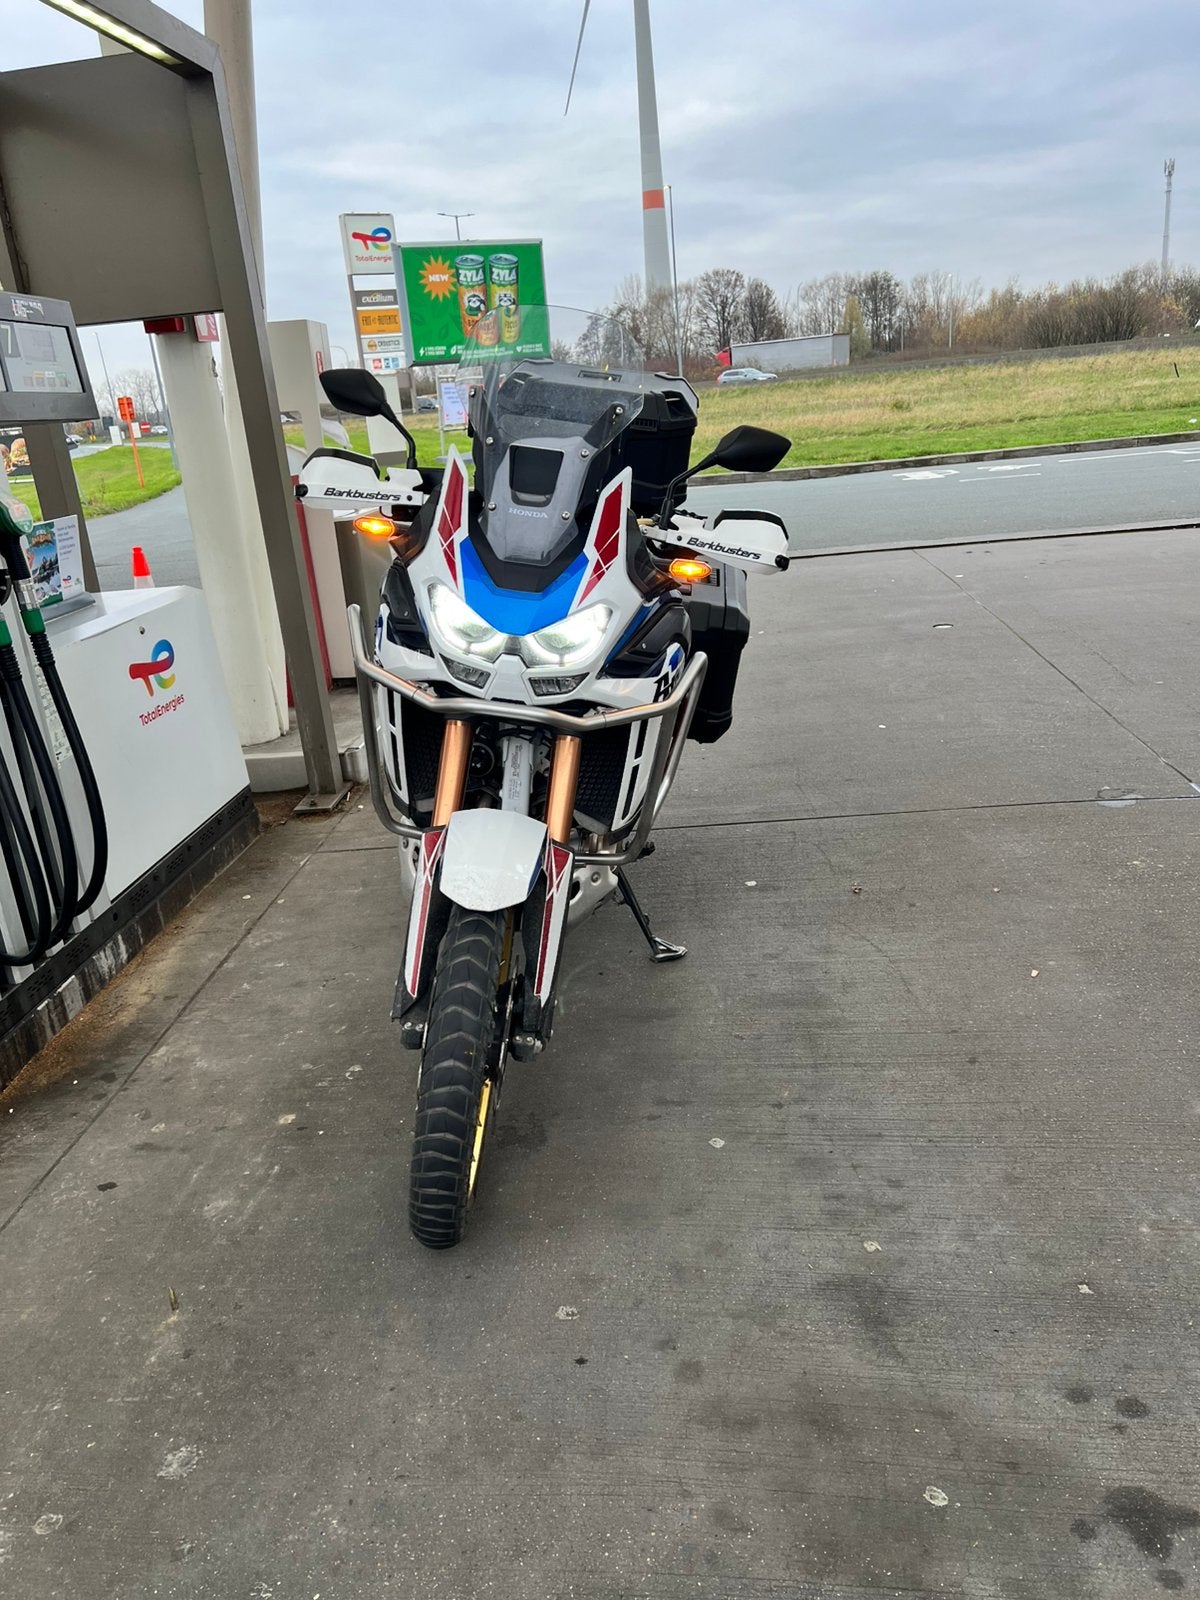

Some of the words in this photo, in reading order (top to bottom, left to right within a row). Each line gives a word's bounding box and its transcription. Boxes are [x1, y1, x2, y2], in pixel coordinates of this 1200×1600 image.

[354, 255, 392, 263] TotalEnergie
[428, 273, 449, 282] NEW
[458, 268, 484, 282] ZYLA
[491, 267, 517, 282] ZYLA
[323, 487, 401, 502] Barkbusters
[508, 507, 549, 519] HONDA
[686, 536, 762, 560] Barkbusters
[139, 694, 185, 726] TotalEnergies
